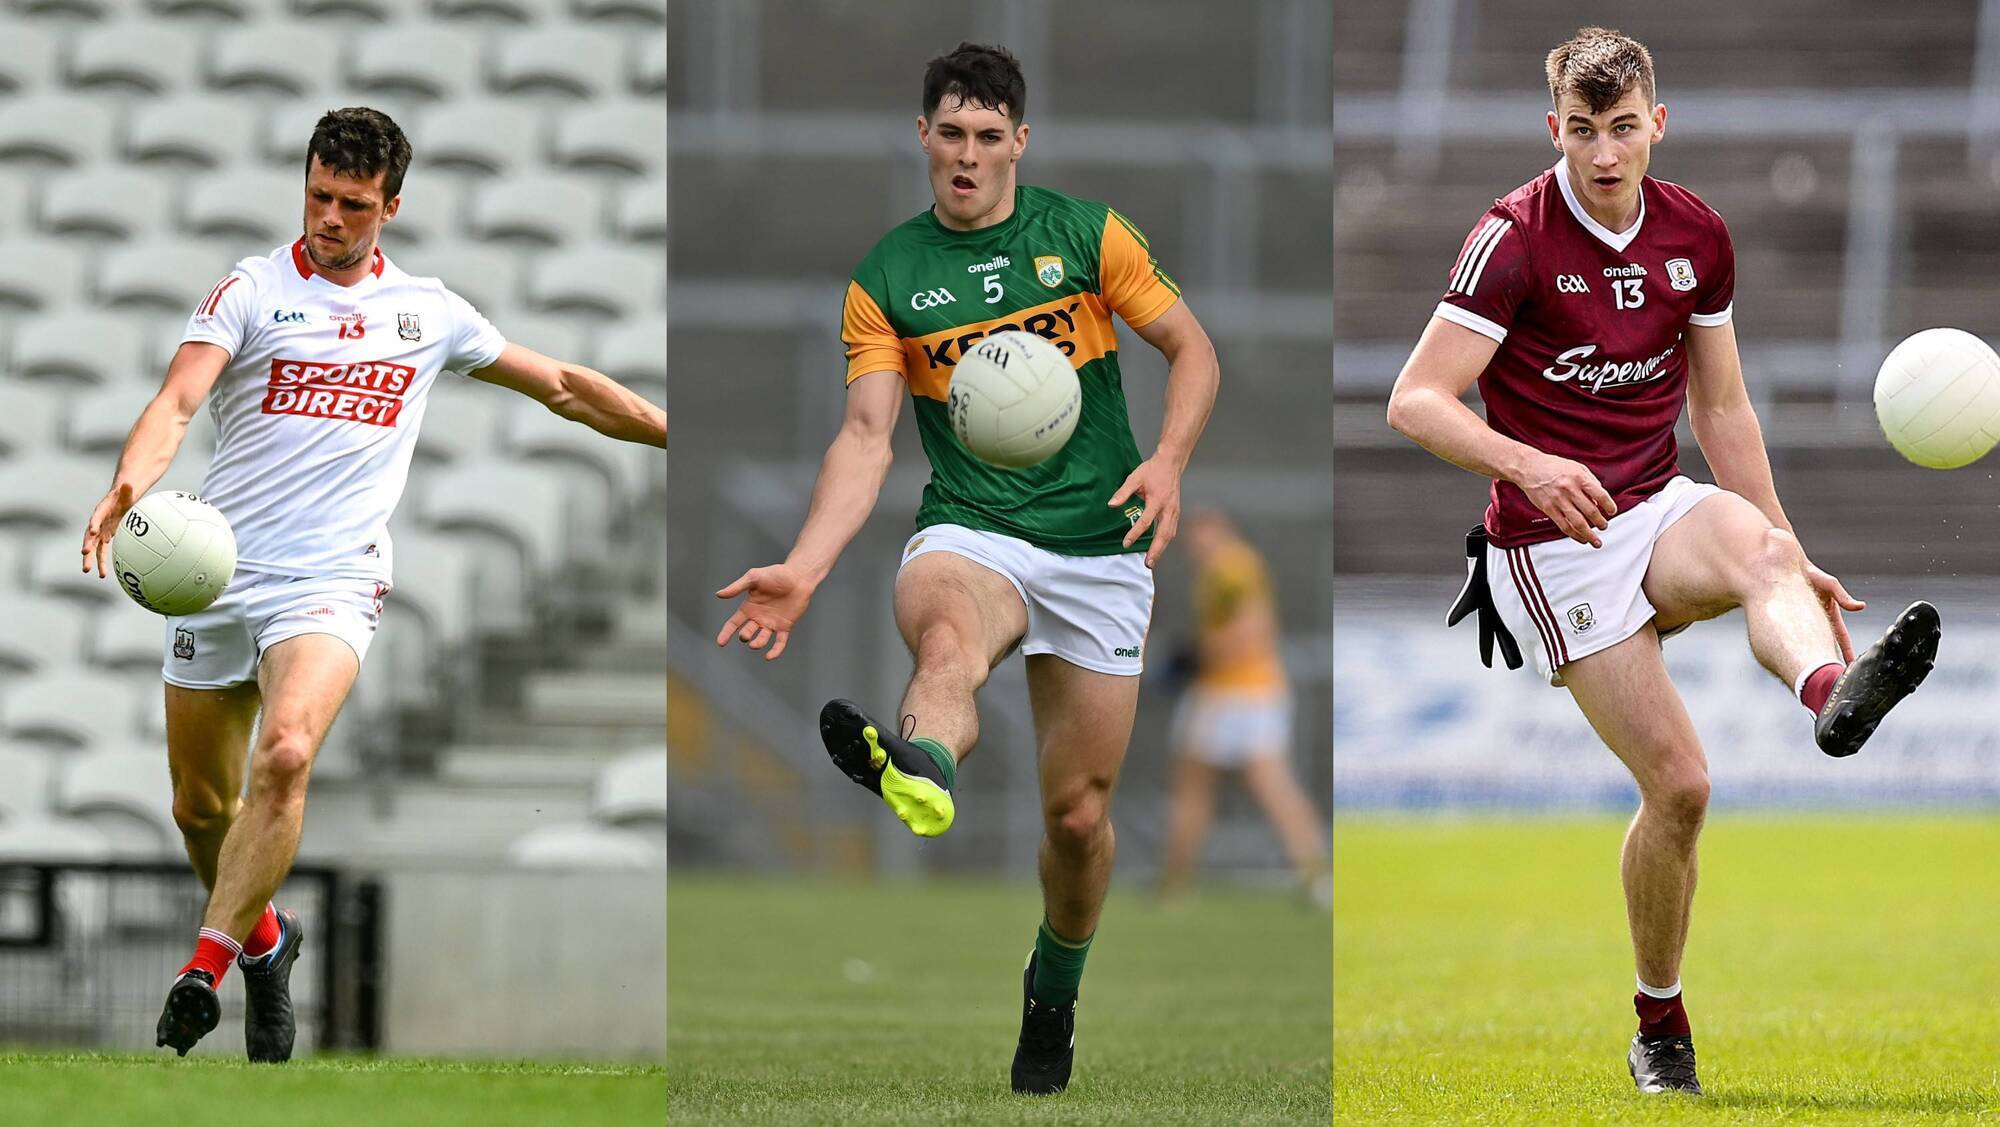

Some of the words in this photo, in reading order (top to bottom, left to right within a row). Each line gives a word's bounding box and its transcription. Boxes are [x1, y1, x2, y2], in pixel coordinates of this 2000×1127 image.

[983, 274, 1004, 304] 5
[1556, 274, 1590, 293] GAA
[1611, 278, 1645, 310] 13
[911, 287, 957, 311] GAA
[338, 320, 366, 340] 13
[278, 363, 409, 392] SPORTS
[270, 389, 394, 423] DIRECT
